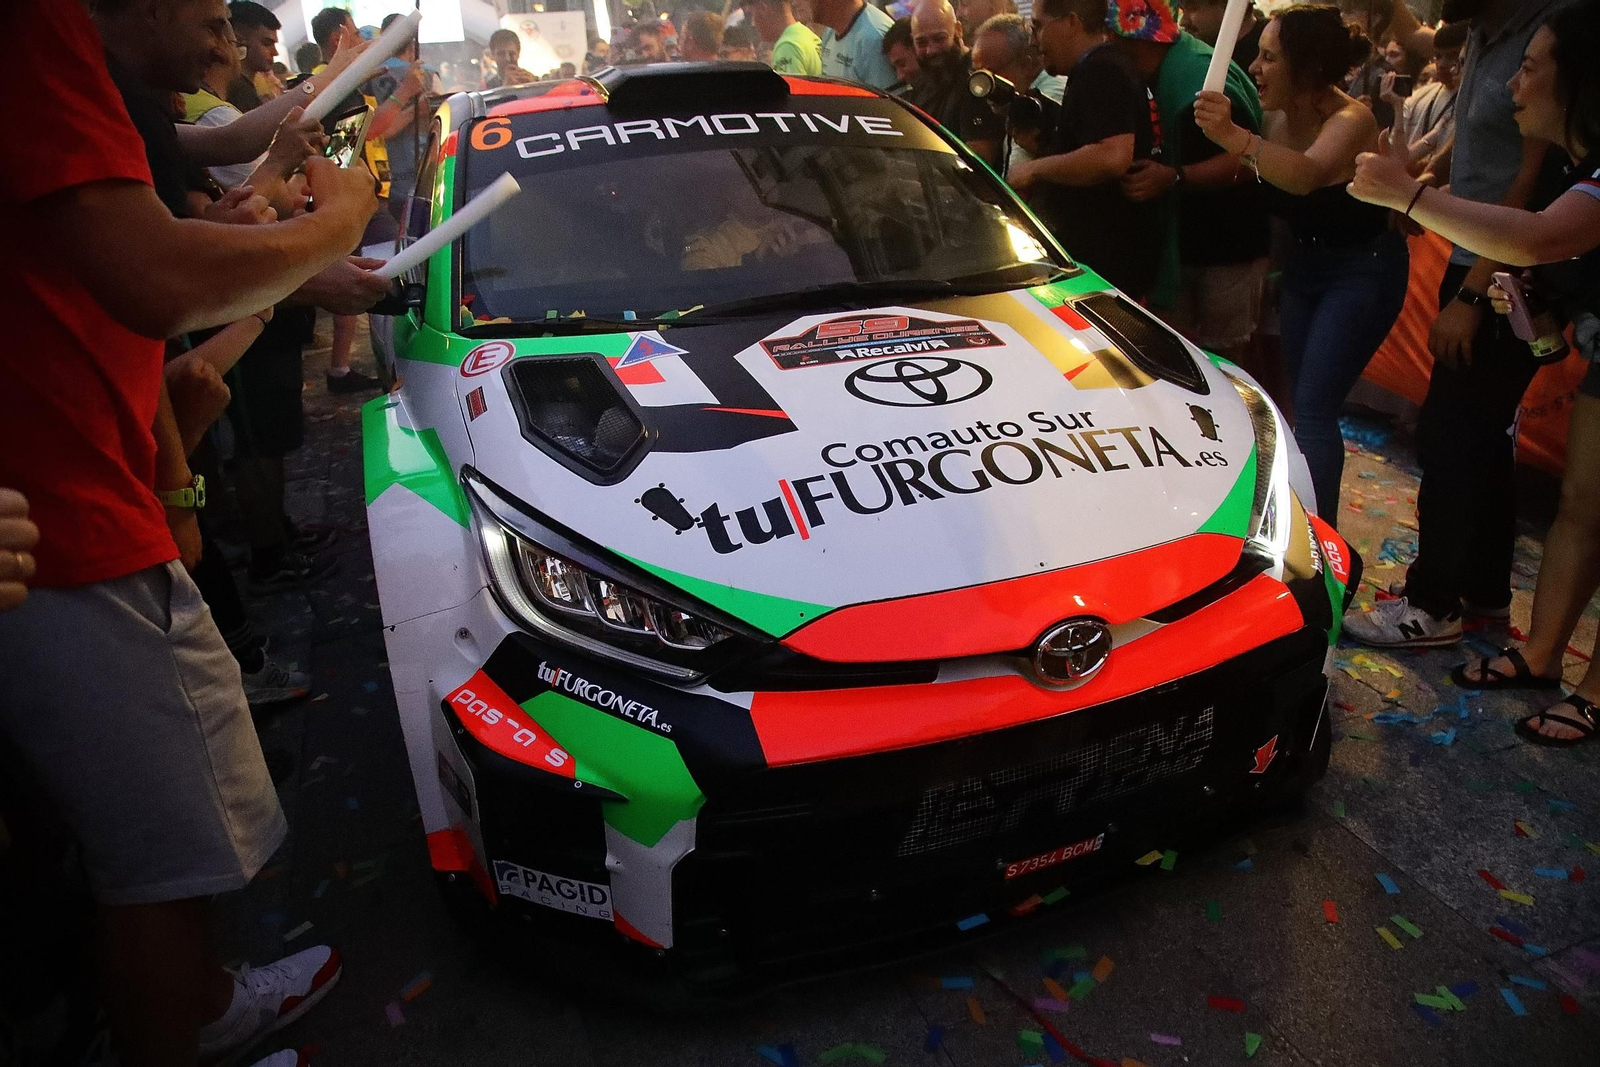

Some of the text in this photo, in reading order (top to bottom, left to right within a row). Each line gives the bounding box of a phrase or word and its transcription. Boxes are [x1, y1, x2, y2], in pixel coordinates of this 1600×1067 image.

[470, 116, 513, 151] 6
[515, 112, 904, 159] CARMOTIVE
[772, 334, 869, 353] RALLYE
[872, 325, 980, 341] OURENSE
[816, 316, 909, 339] 59
[821, 407, 1095, 467] Comauto Sur
[500, 883, 611, 919] RACING
[522, 870, 608, 906] PAGID
